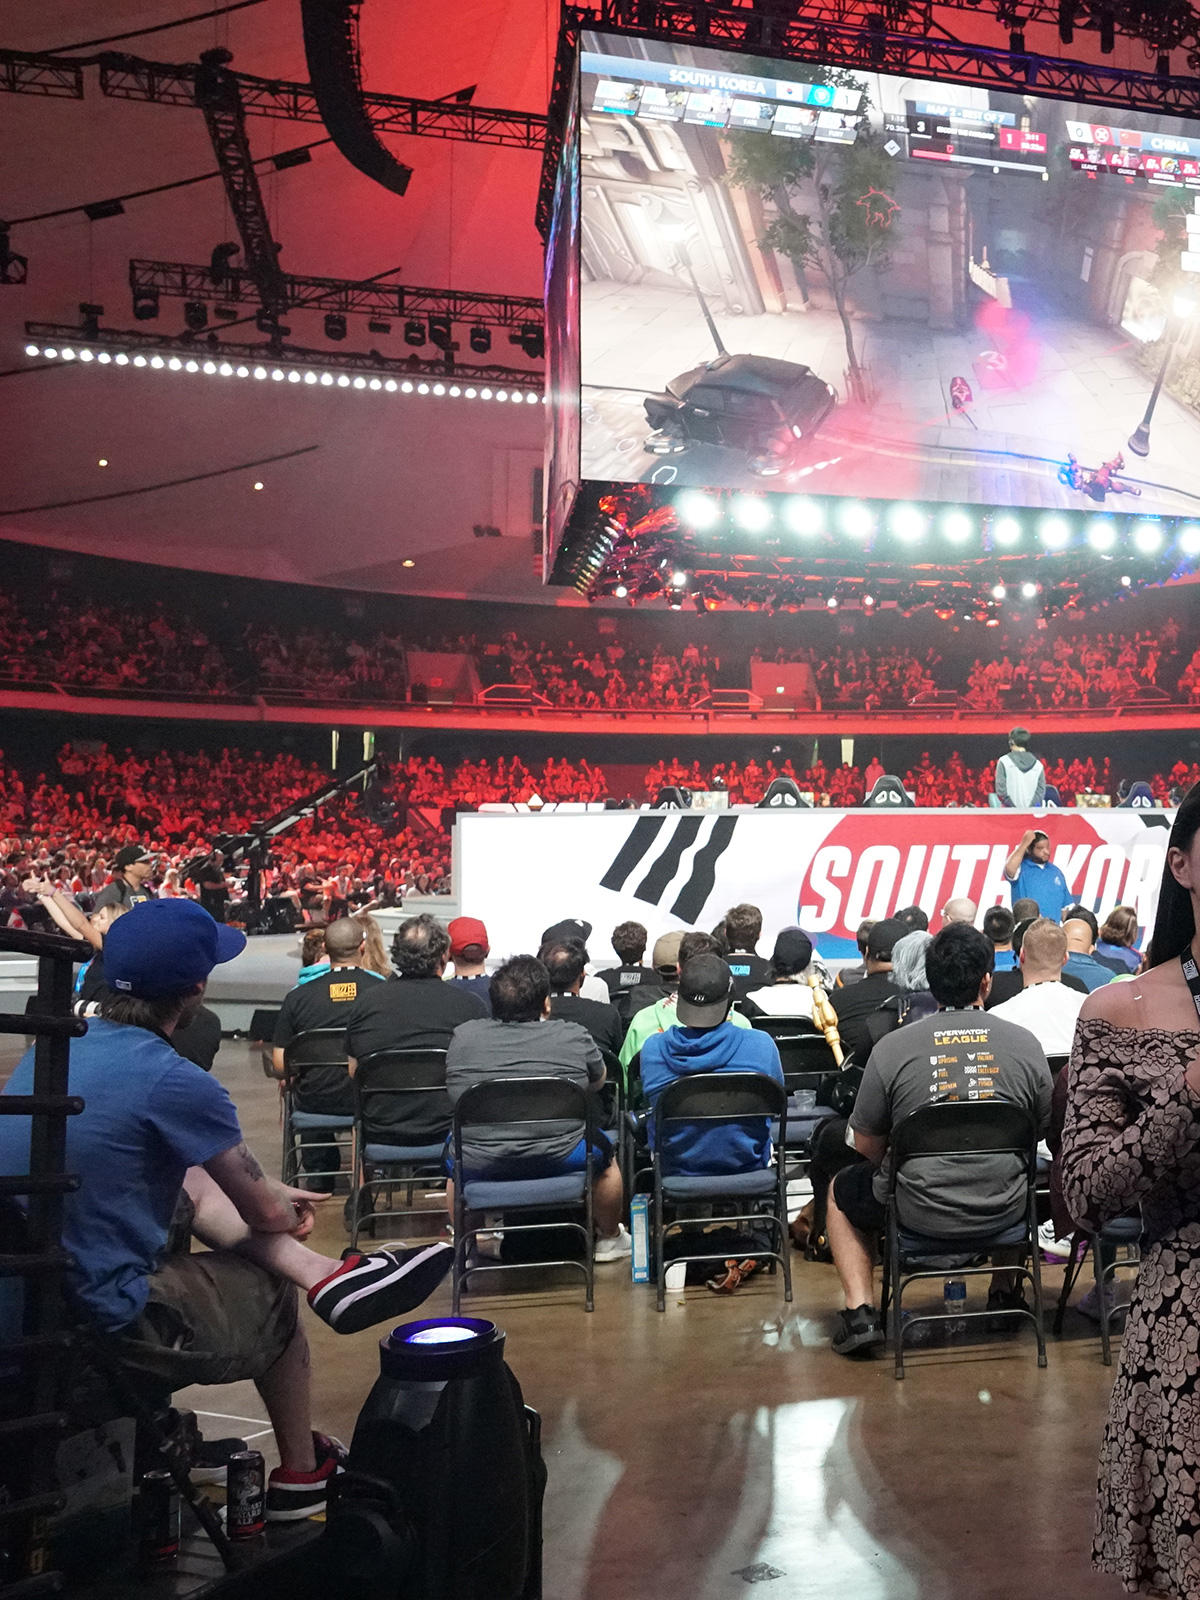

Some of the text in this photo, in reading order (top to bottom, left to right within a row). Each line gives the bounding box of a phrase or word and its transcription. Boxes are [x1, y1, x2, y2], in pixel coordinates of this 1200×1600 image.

[669, 69, 766, 95] SOUTH KOREA
[926, 104, 948, 115] MAP
[950, 107, 957, 116] 2
[962, 109, 982, 119] BEST
[984, 112, 996, 121] OF
[998, 114, 1005, 123] 7
[917, 121, 925, 132] 3
[1006, 133, 1012, 144] 1
[1151, 137, 1190, 153] CHINA
[799, 844, 1167, 933] SOUTH KOR
[934, 1029, 988, 1037] OVERWATCH
[934, 1035, 988, 1045] LEAGUE
